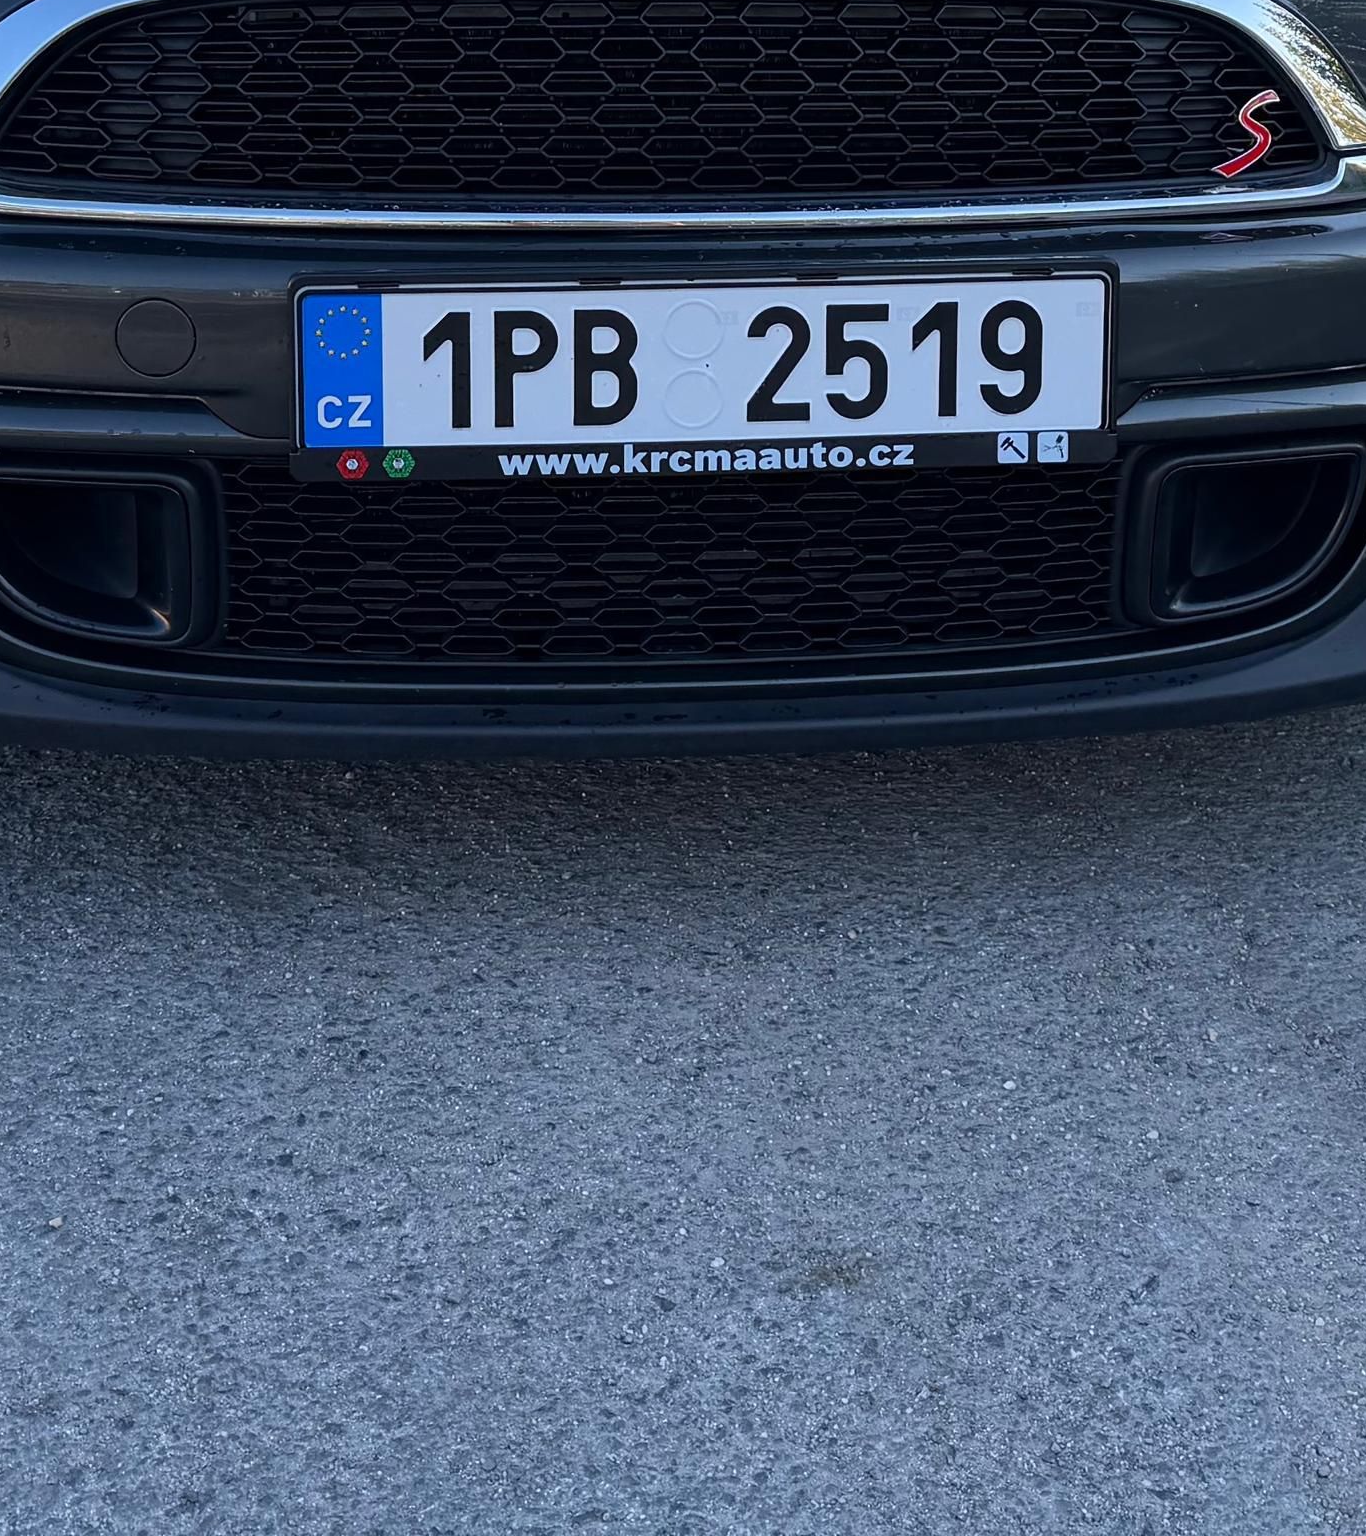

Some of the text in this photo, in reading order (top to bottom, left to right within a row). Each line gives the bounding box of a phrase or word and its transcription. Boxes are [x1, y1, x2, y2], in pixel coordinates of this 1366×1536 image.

[1211, 89, 1281, 179] S
[421, 299, 1044, 429] 1PB 2519
[317, 395, 372, 429] CZ
[498, 442, 915, 476] www.krcmaauto.cz
